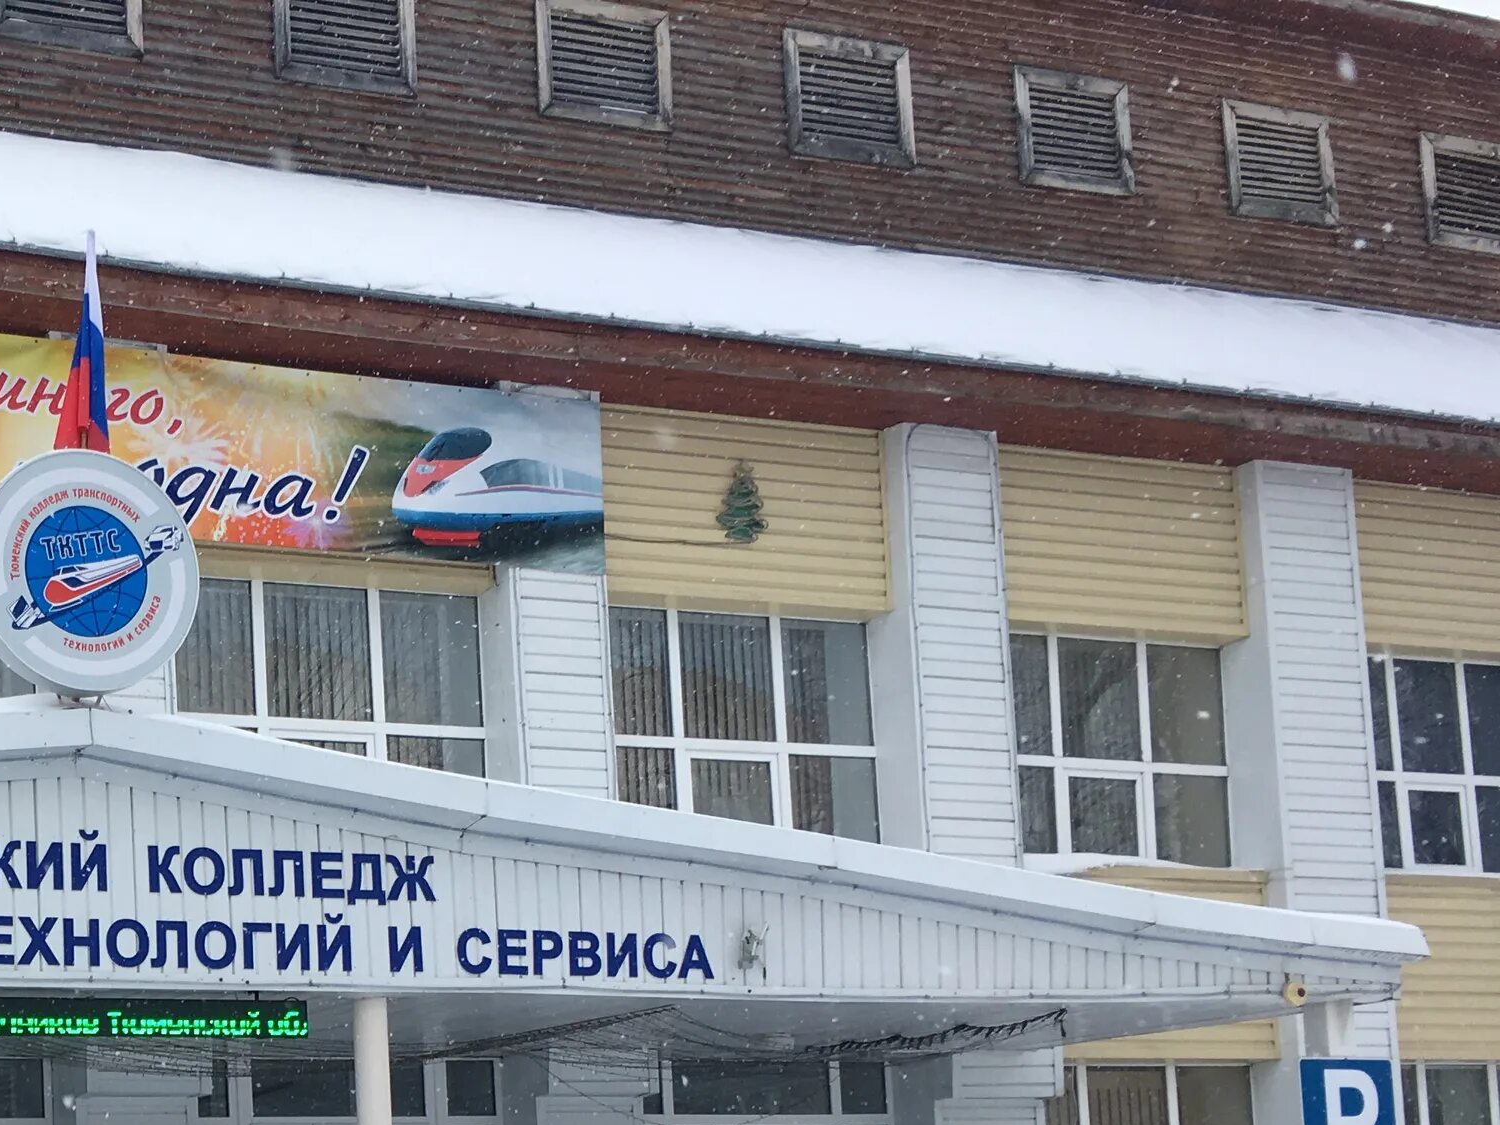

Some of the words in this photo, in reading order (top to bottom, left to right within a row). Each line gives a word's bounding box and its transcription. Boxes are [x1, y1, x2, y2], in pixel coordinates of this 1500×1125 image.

[10, 516, 31, 581] Тюменский
[28, 488, 69, 520] колледж
[72, 488, 141, 523] транспортных
[40, 528, 122, 561] ТКТТС
[63, 637, 125, 653] технологий
[126, 632, 134, 642] и
[135, 595, 161, 636] сервиса
[147, 845, 437, 906] КОЛЛЕДЖ
[387, 926, 424, 974] И
[456, 928, 716, 980] СЕРВИСА
